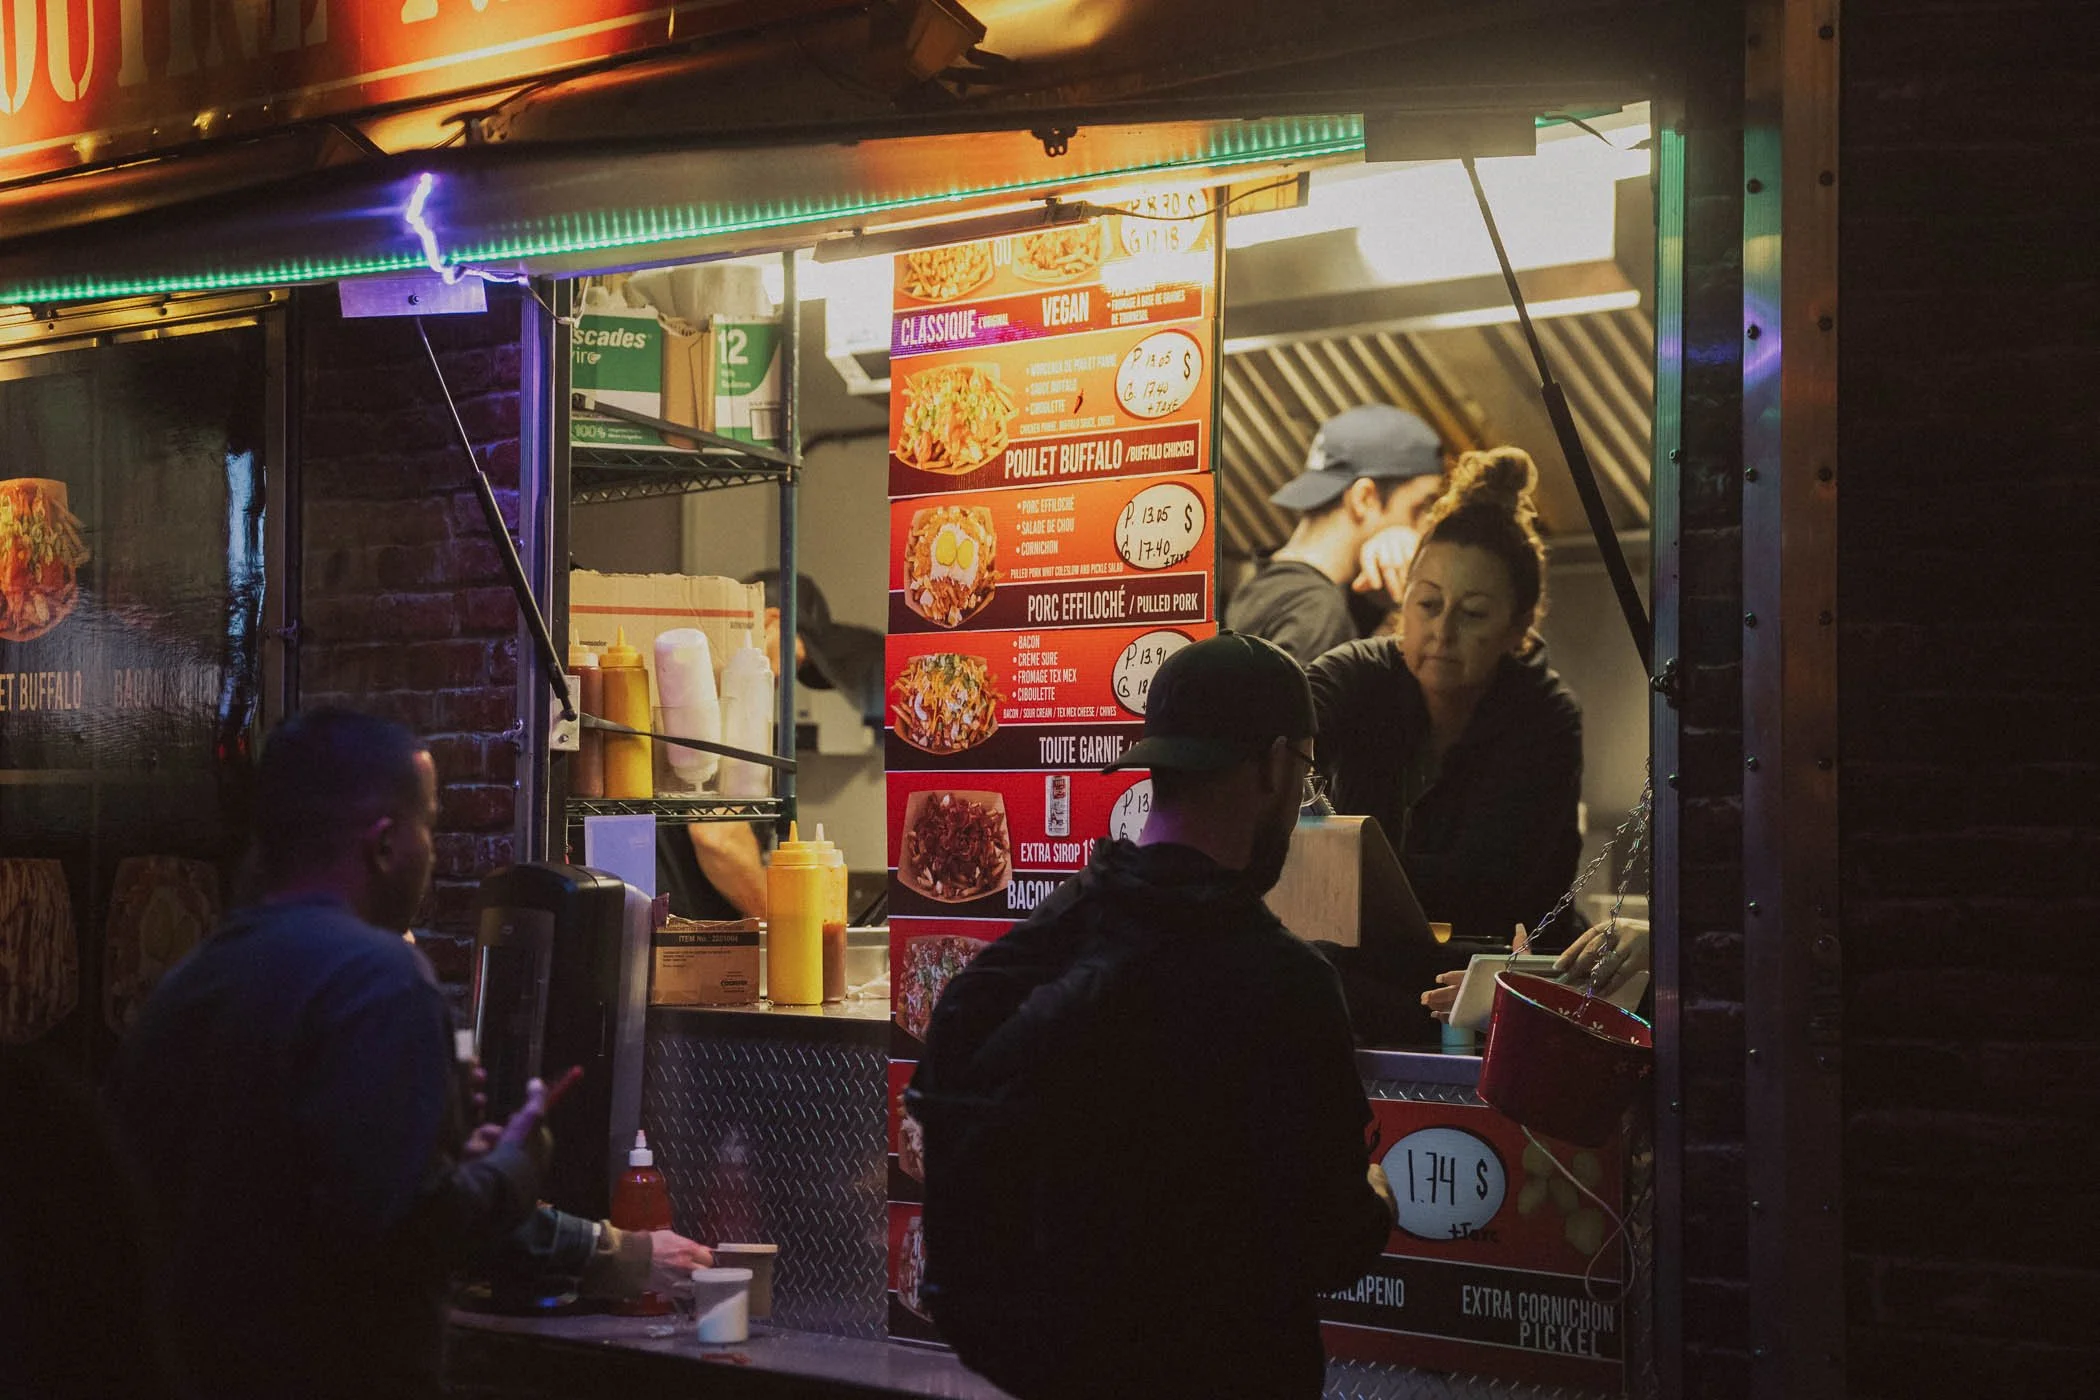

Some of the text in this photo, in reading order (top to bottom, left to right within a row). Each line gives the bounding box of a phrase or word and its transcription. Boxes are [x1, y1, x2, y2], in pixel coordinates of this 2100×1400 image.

[1041, 292, 1090, 327] VEGAN
[901, 309, 977, 346] CLASSIQUE
[718, 328, 749, 365] 12
[1183, 349, 1191, 380] $
[1004, 445, 1057, 479] POULET
[1059, 438, 1123, 474] BUFFALO
[1163, 439, 1195, 458] CHICKEN
[1022, 498, 1039, 514] PORC
[1184, 503, 1193, 533] $
[1021, 517, 1075, 535] SALADE DE CHOU
[1021, 540, 1058, 556] CORNICHON
[1027, 592, 1059, 622] PORC
[1062, 584, 1126, 620] EFFILOCHÉ
[1137, 594, 1170, 614] PULLED
[1173, 592, 1198, 611] PORK
[1018, 635, 1040, 650] BACON
[1041, 651, 1058, 665] SURE
[19, 670, 83, 711] BUFFALO
[1017, 668, 1077, 684] FROMAGE TEX MEX
[1017, 687, 1055, 702] CIBOULETTE
[1003, 708, 1018, 719] BACON
[1023, 708, 1036, 719] SOUR
[1036, 707, 1052, 718] CREAM
[1057, 707, 1065, 717] TEX
[1065, 707, 1077, 717] MEX
[1077, 706, 1095, 717] CHEESE
[1099, 706, 1117, 717] CHIVES
[1039, 736, 1076, 764] TOUTE
[1021, 842, 1051, 863] EXTRA
[1053, 842, 1080, 863] SIROP
[1407, 1149, 1488, 1205] 1.74 $
[1461, 1284, 1614, 1333] EXTRA CORNICHON
[1519, 1323, 1602, 1358] PICKEL
